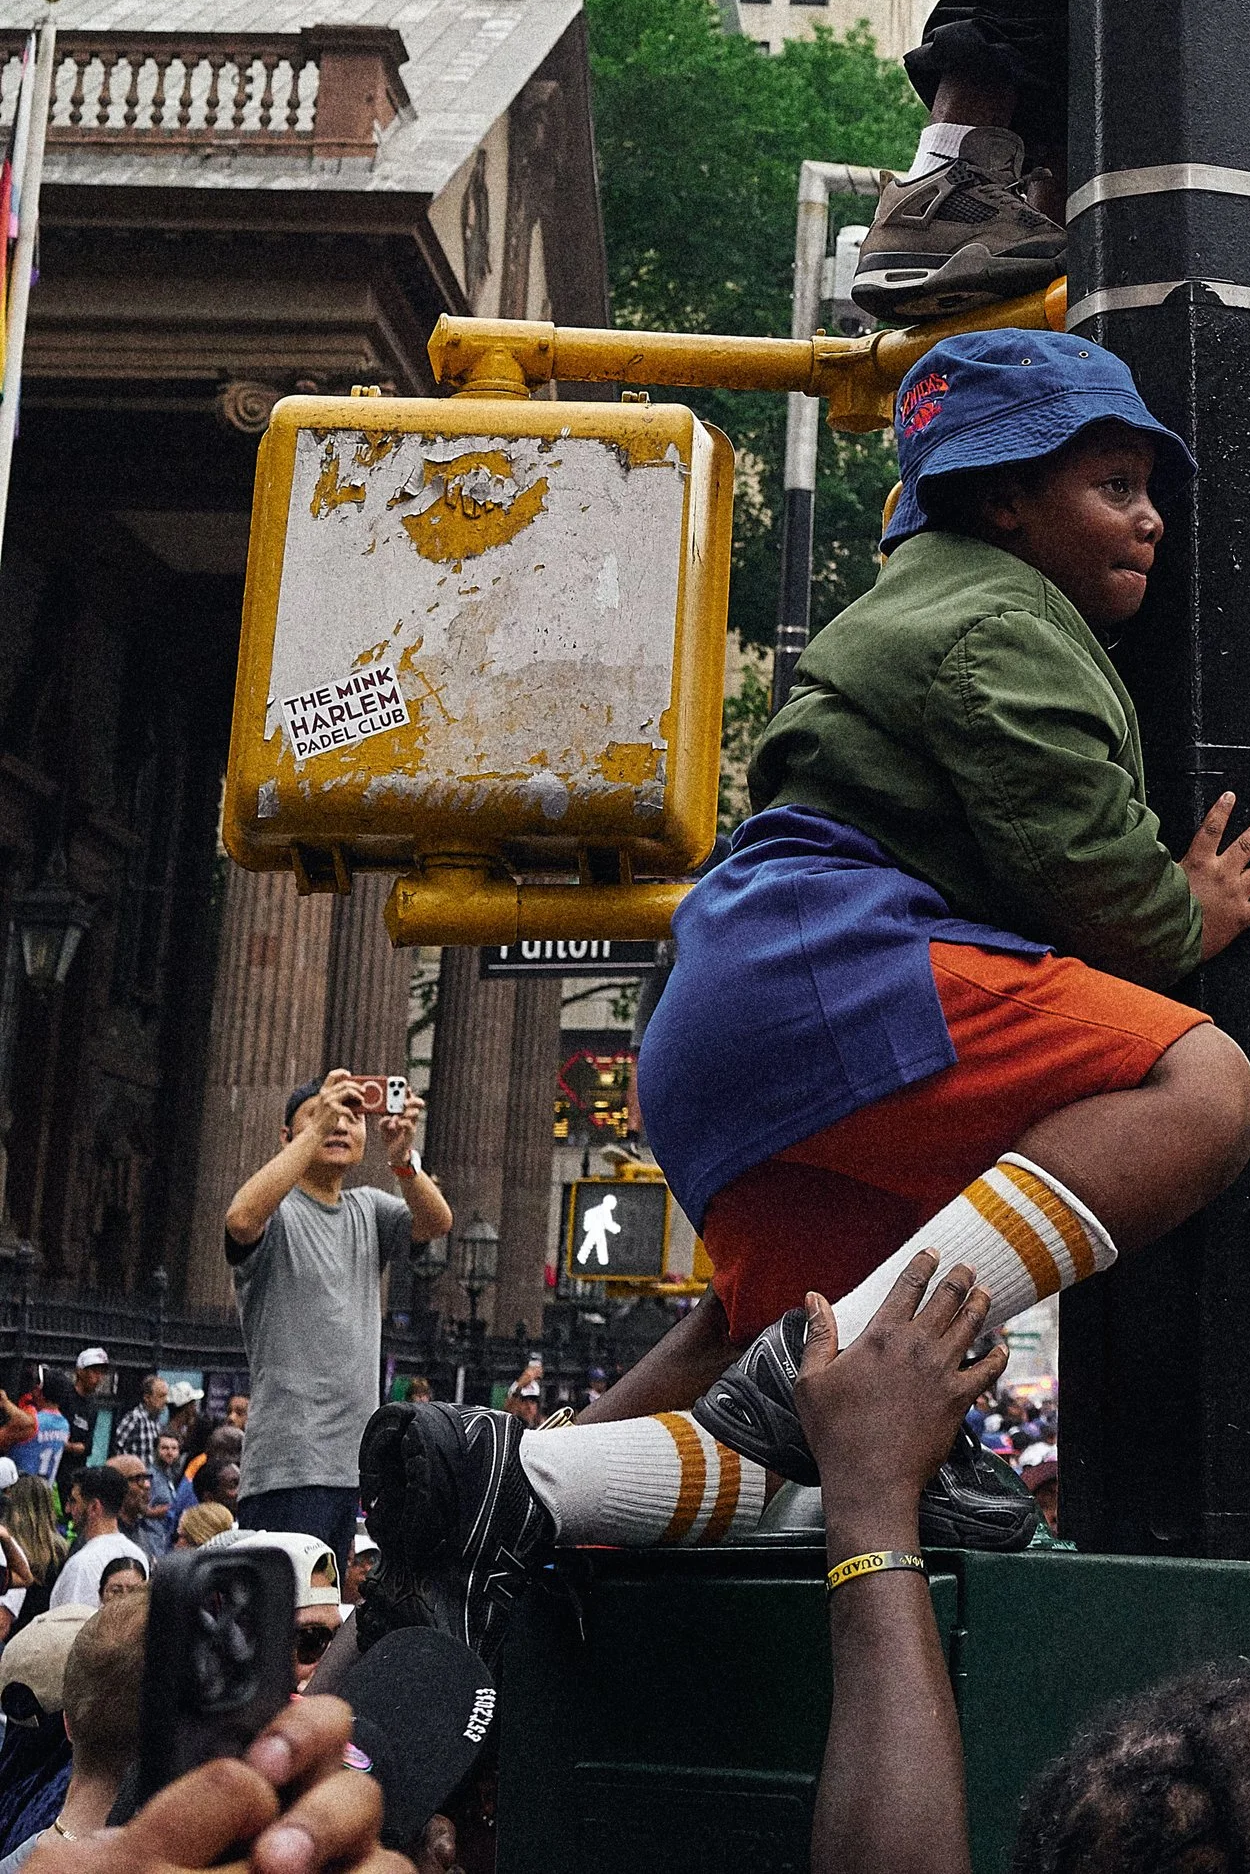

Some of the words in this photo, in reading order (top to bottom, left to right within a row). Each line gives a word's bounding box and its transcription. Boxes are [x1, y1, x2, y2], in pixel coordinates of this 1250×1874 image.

[284, 687, 332, 715] THE
[335, 666, 393, 699] MINK
[290, 685, 400, 739] HARLEM
[296, 727, 356, 756] PADEL
[358, 708, 405, 734] CLUB
[842, 1554, 884, 1576] QUAD
